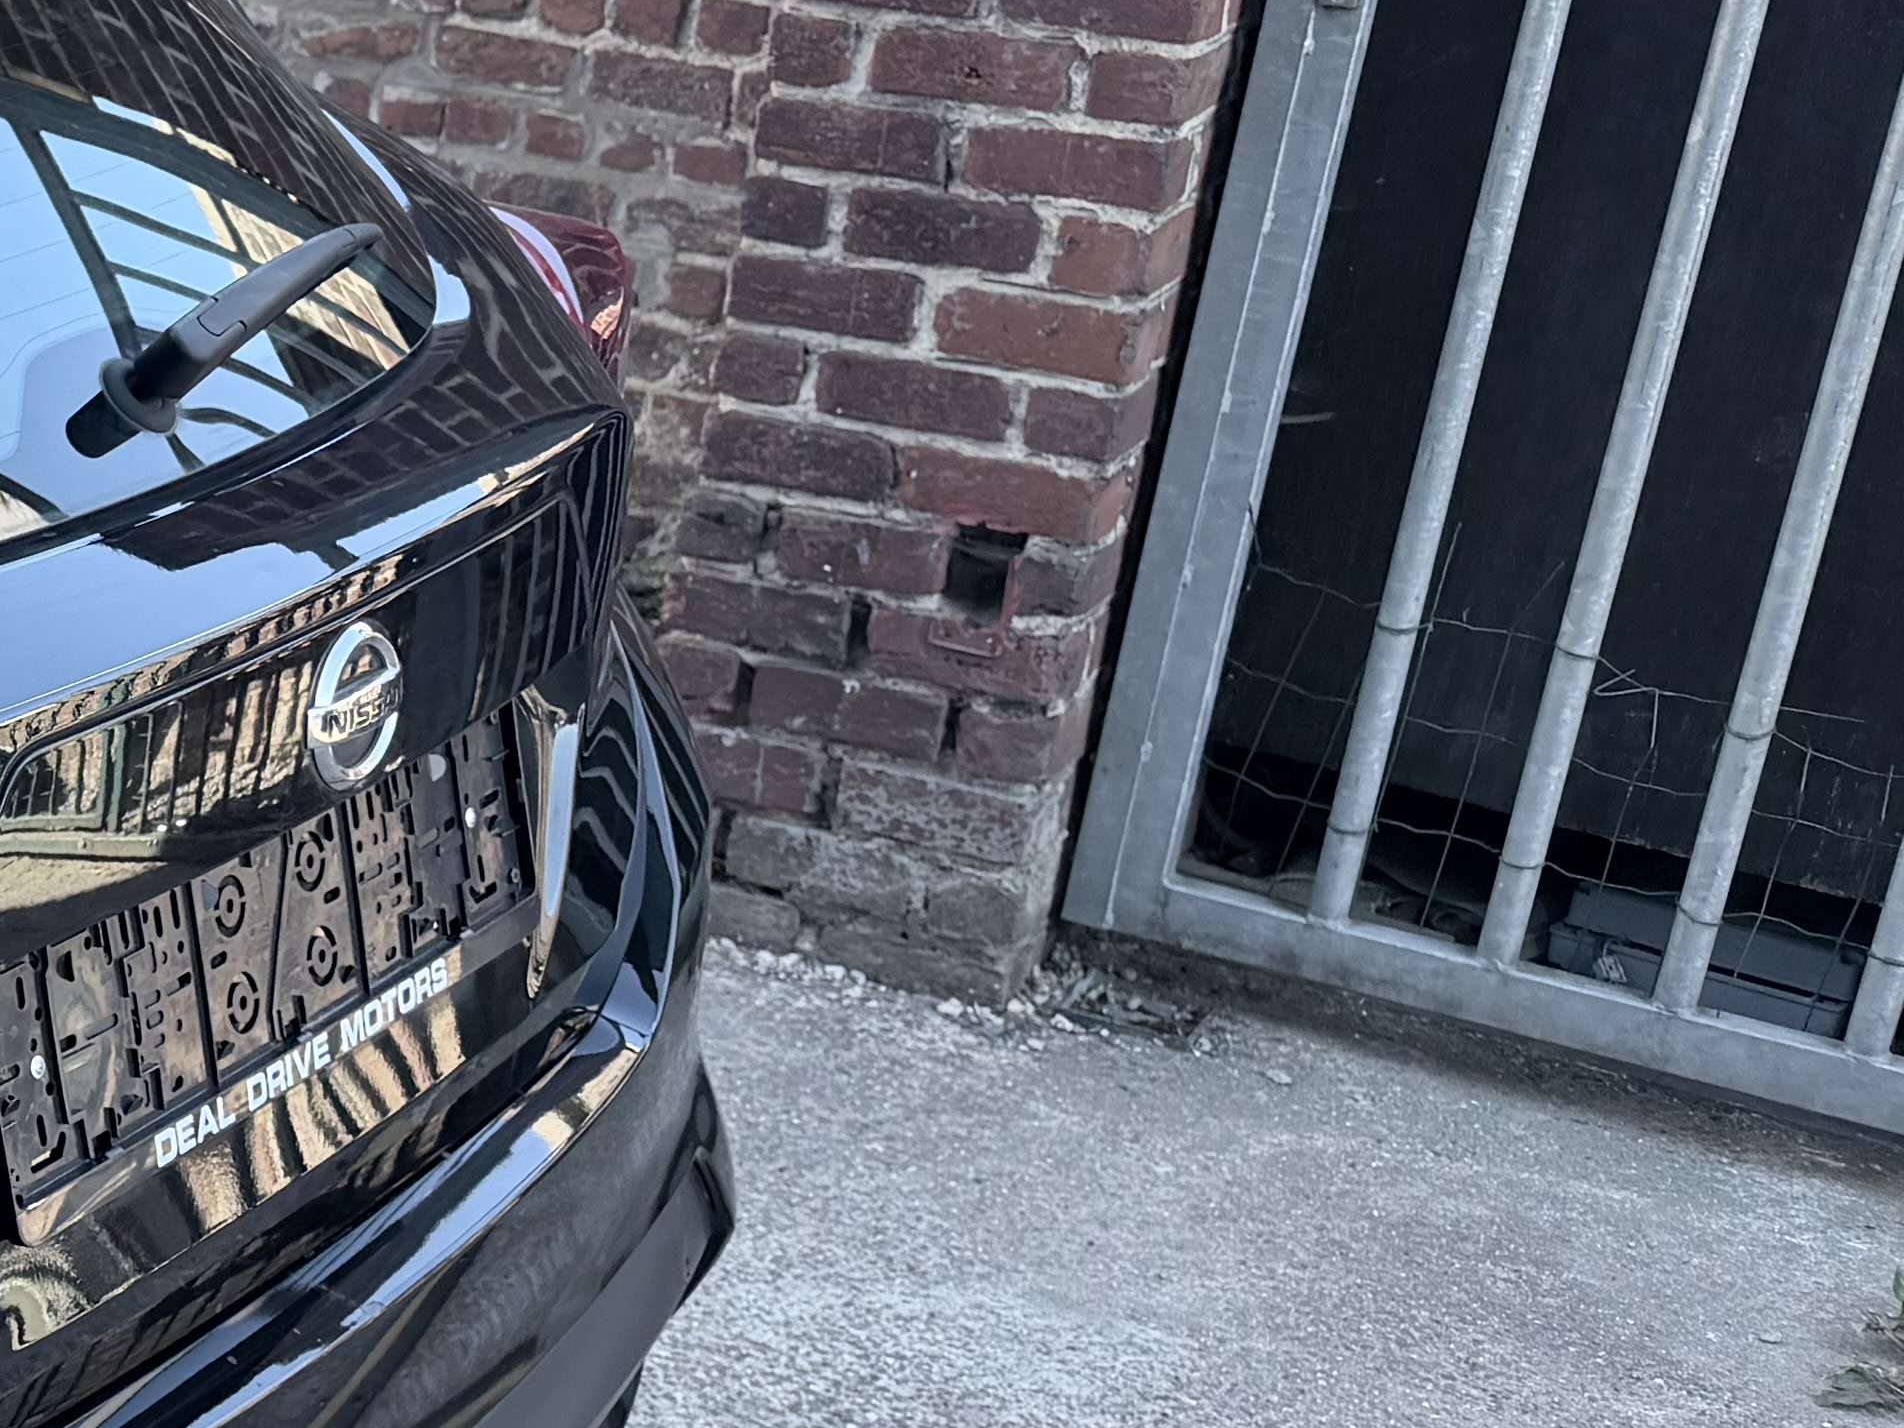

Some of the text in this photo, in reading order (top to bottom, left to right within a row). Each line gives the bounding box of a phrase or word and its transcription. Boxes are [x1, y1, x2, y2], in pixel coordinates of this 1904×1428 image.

[154, 956, 449, 1169] DEAL DRIVE MOTORS
